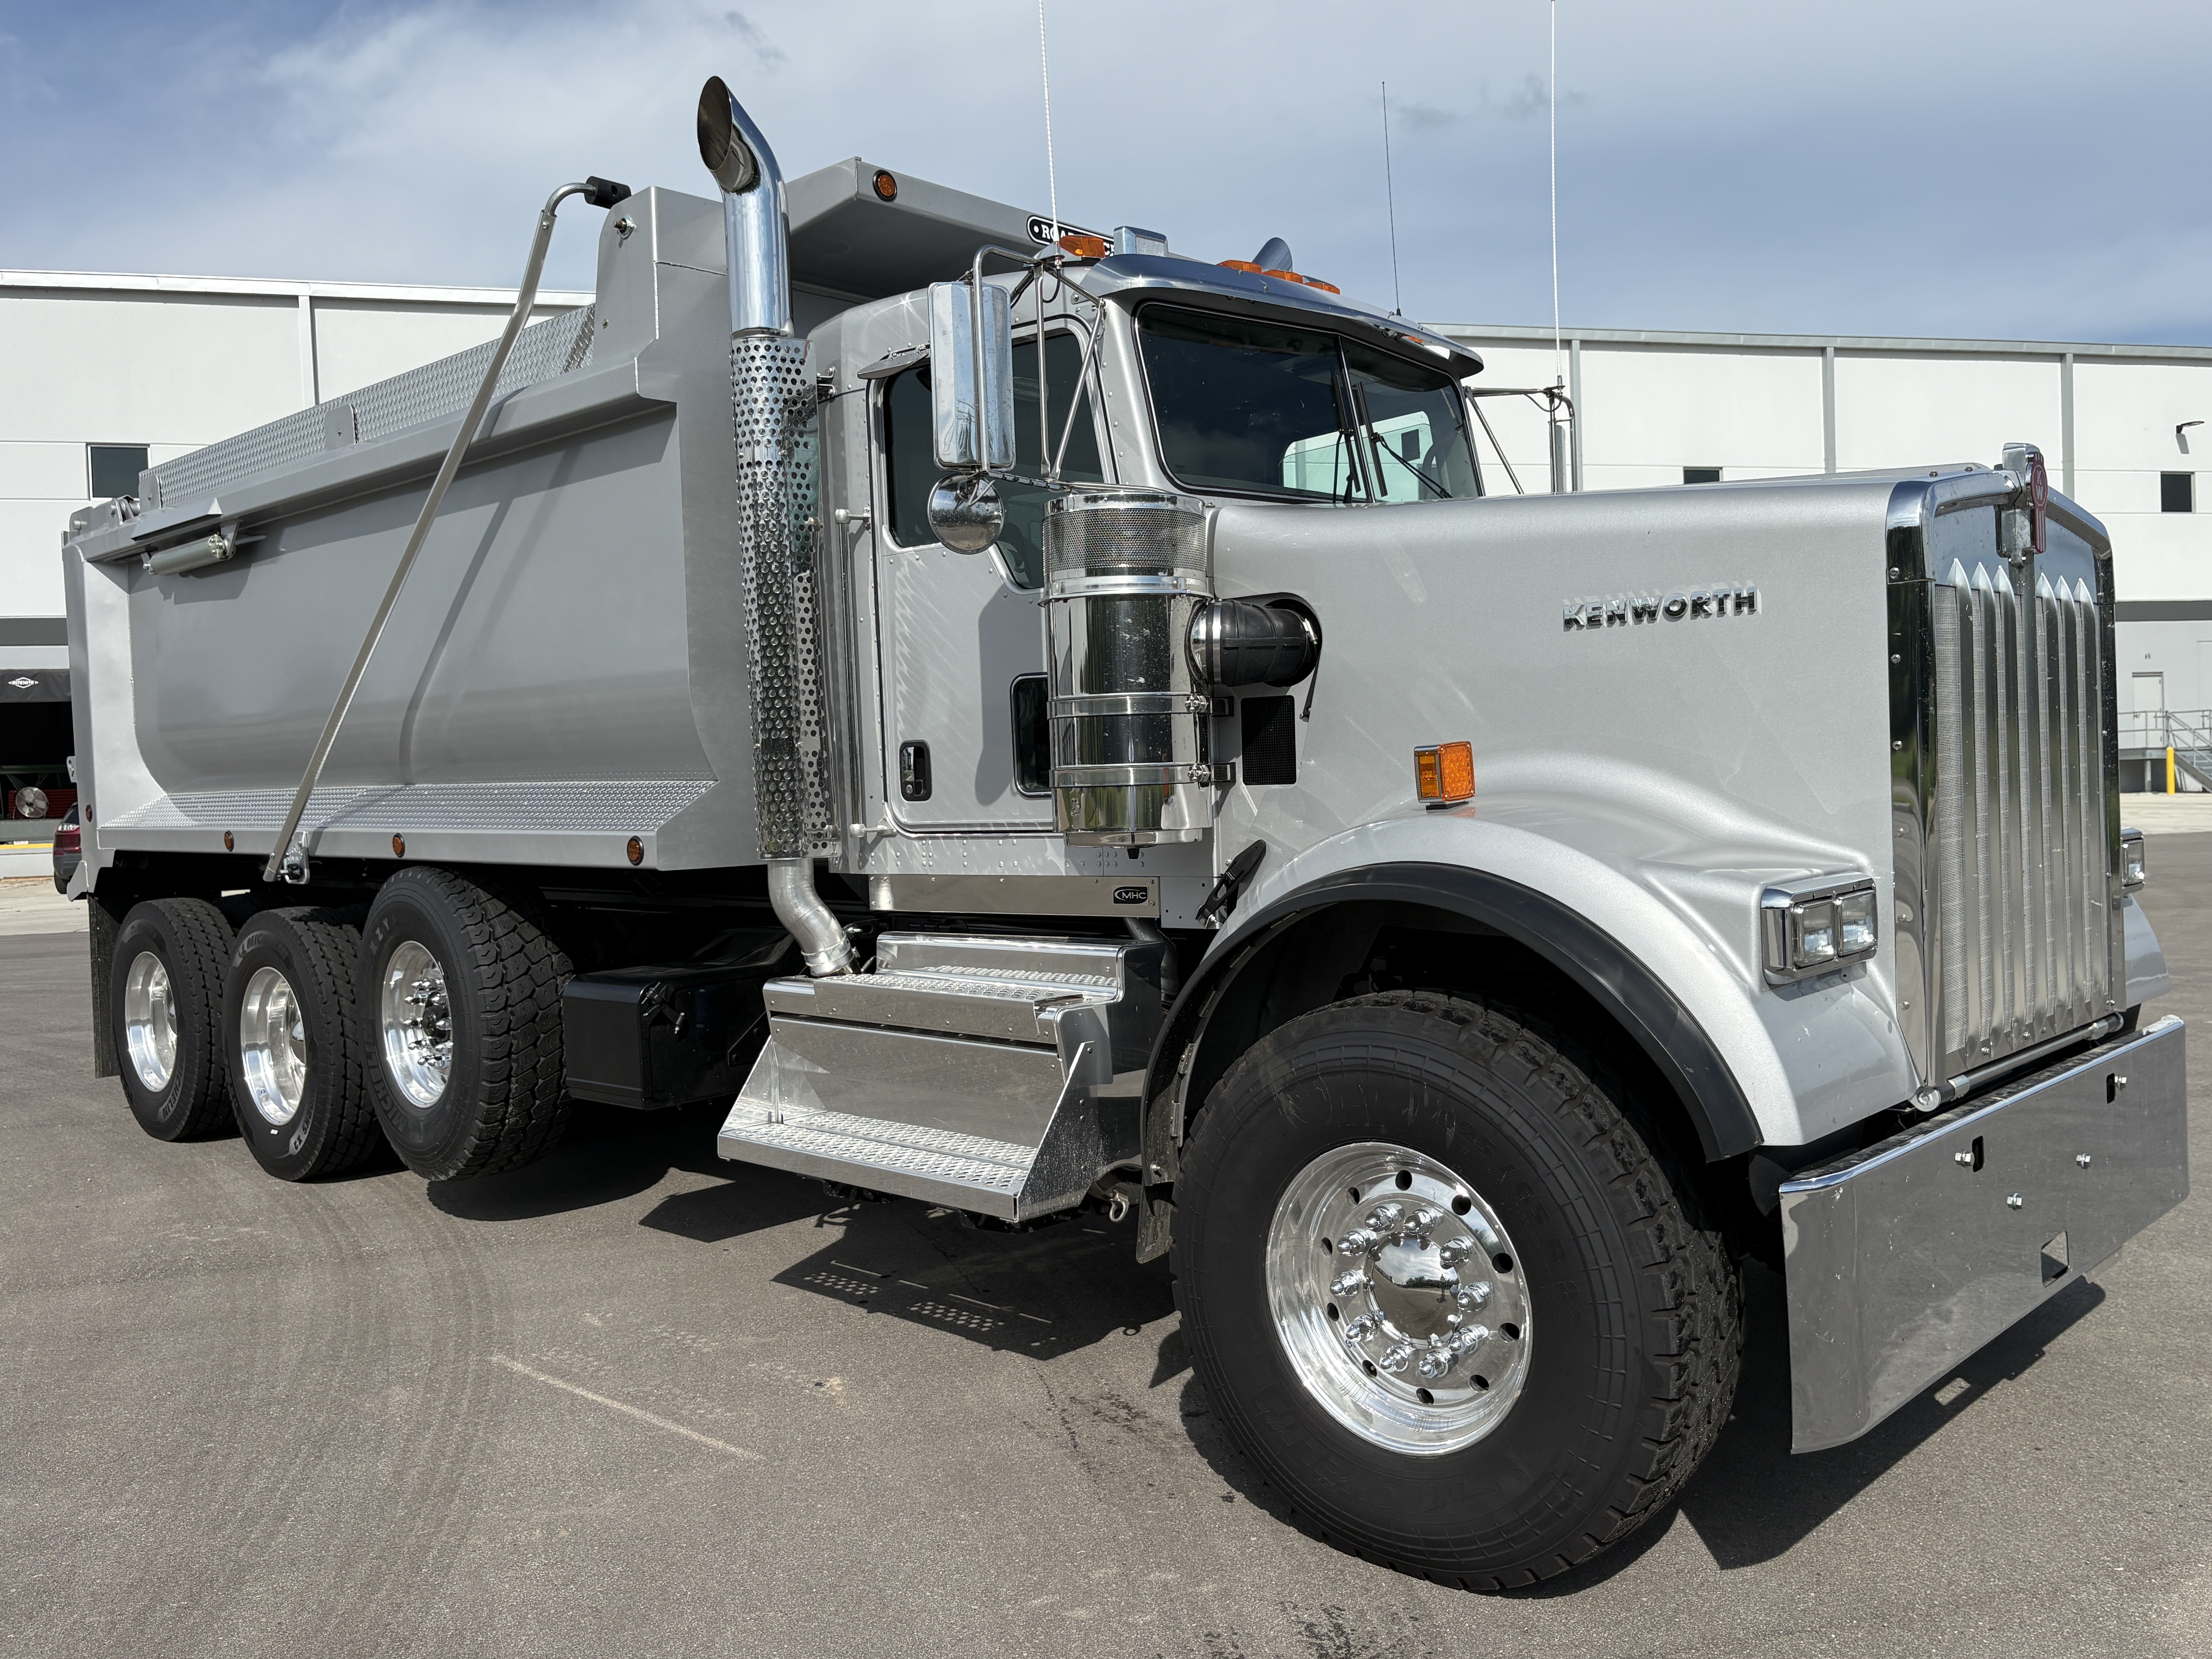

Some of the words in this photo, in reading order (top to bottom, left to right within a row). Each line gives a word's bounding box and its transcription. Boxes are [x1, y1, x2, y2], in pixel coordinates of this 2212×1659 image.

[1563, 586, 1758, 631] KENWORTH
[1122, 891, 1147, 900] MHC
[163, 1054, 185, 1119] MICHELIN
[363, 1019, 409, 1132] MICHELIN
